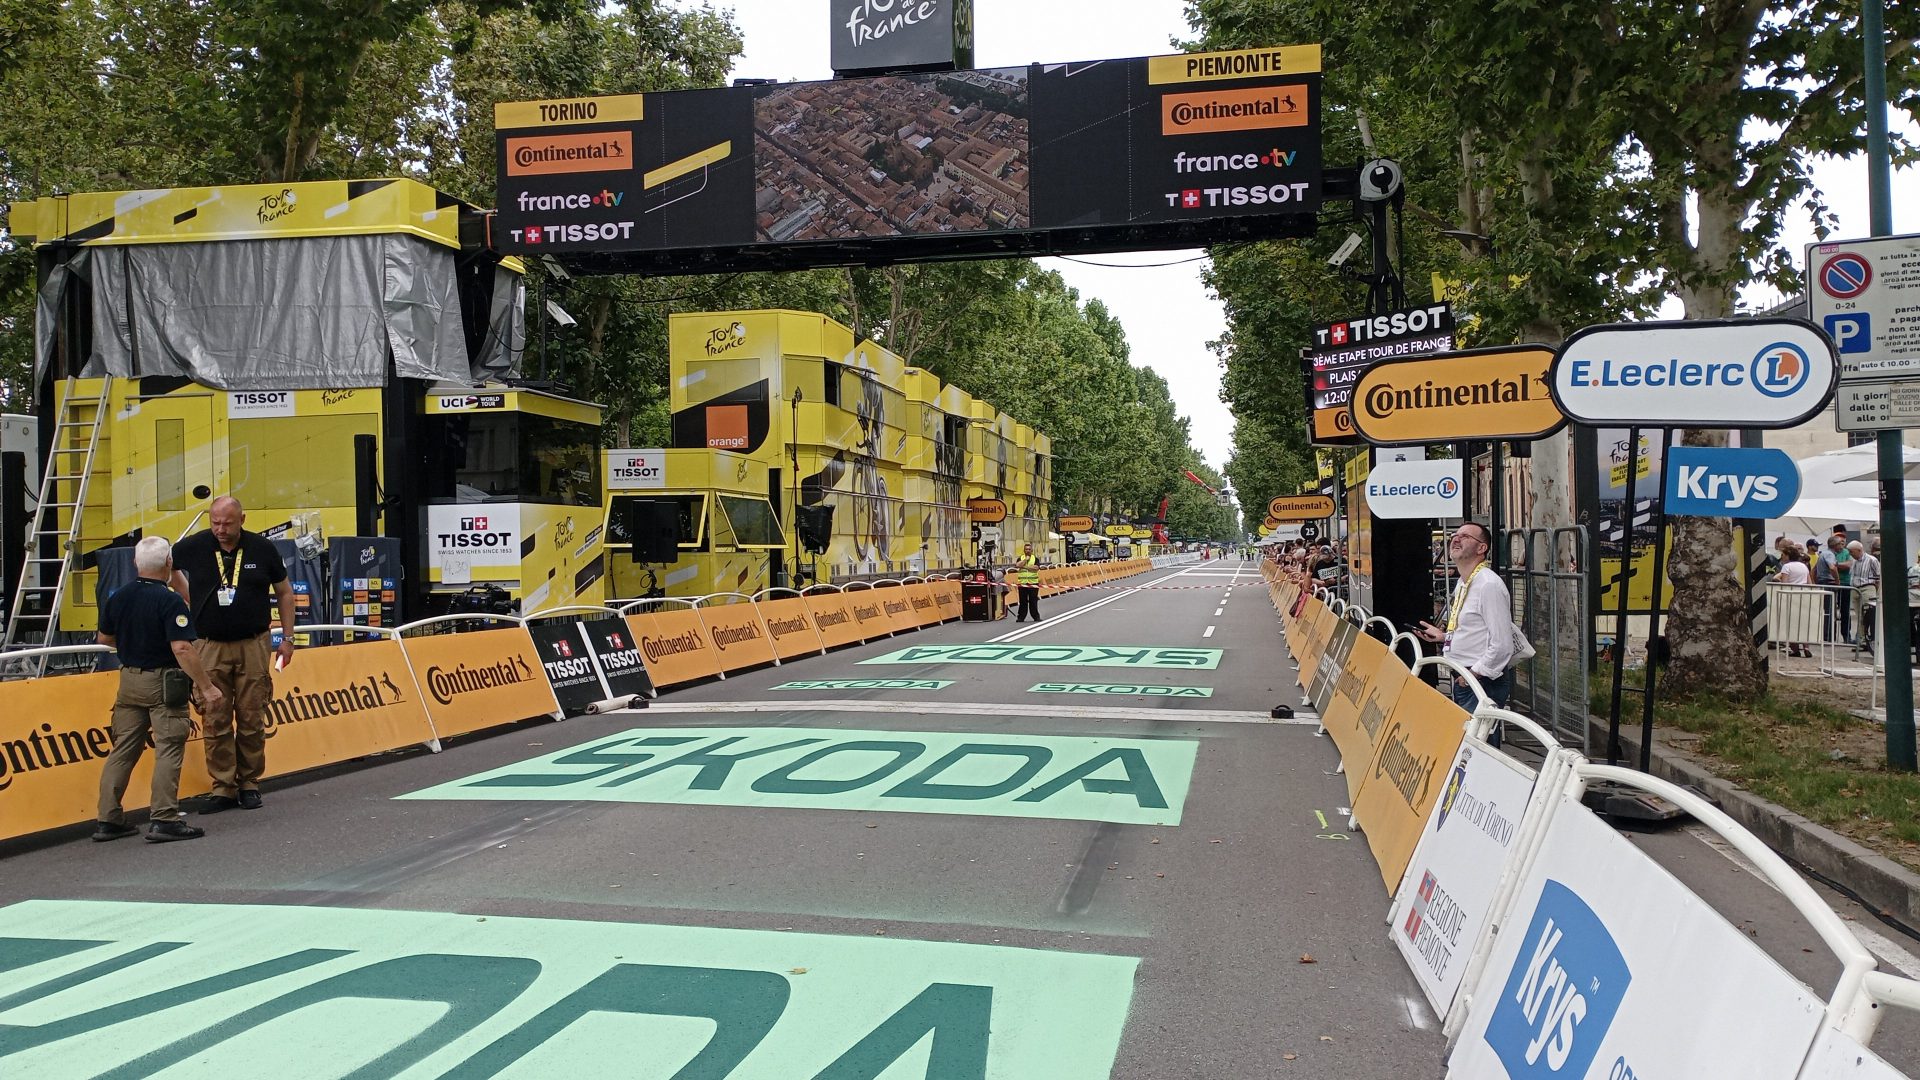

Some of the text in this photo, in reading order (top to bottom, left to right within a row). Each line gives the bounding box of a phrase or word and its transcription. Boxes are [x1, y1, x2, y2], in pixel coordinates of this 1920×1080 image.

[846, 2, 937, 47] france
[1187, 52, 1282, 77] PIEMONTE
[539, 101, 598, 122] TORINO
[1171, 97, 1280, 126] Continental
[514, 142, 609, 167] Continental
[1203, 182, 1309, 206] TISSOT
[257, 204, 296, 224] france
[543, 221, 635, 242] TISSOT
[1350, 305, 1446, 341] TISSOT
[1834, 320, 1860, 348] P
[705, 337, 744, 357] france
[1313, 336, 1452, 367] 3ÈME ETAPE TOUR DE FRANCE
[1329, 369, 1362, 385] PLAIS
[1571, 359, 1745, 388] E.Leclerc
[235, 393, 287, 404] TISSOT
[441, 398, 463, 408] UCI
[1364, 373, 1531, 420] Continental
[1849, 404, 1875, 412] dalle
[709, 437, 744, 448] orange
[614, 468, 659, 477] TISSOT
[1369, 484, 1436, 496] E.Leclerc
[1677, 465, 1779, 509] Krys
[1273, 501, 1322, 513] Continental
[438, 533, 511, 548] TISSOT
[1305, 528, 1315, 536] 25
[767, 614, 805, 641] Continental
[814, 608, 848, 632] Continental
[642, 630, 696, 664] Continental
[712, 622, 756, 651] Continental
[544, 656, 591, 679] TISSOT
[599, 648, 642, 670] TISSOT
[427, 657, 522, 706] Continental
[264, 676, 386, 739] ontinental
[1375, 722, 1430, 807] Continental
[1473, 802, 1487, 826] DI
[1482, 801, 1513, 847] TORINO
[1426, 884, 1467, 948] REGIONE
[1414, 918, 1452, 982] PIEMONTE
[1516, 917, 1587, 1071] Krys
